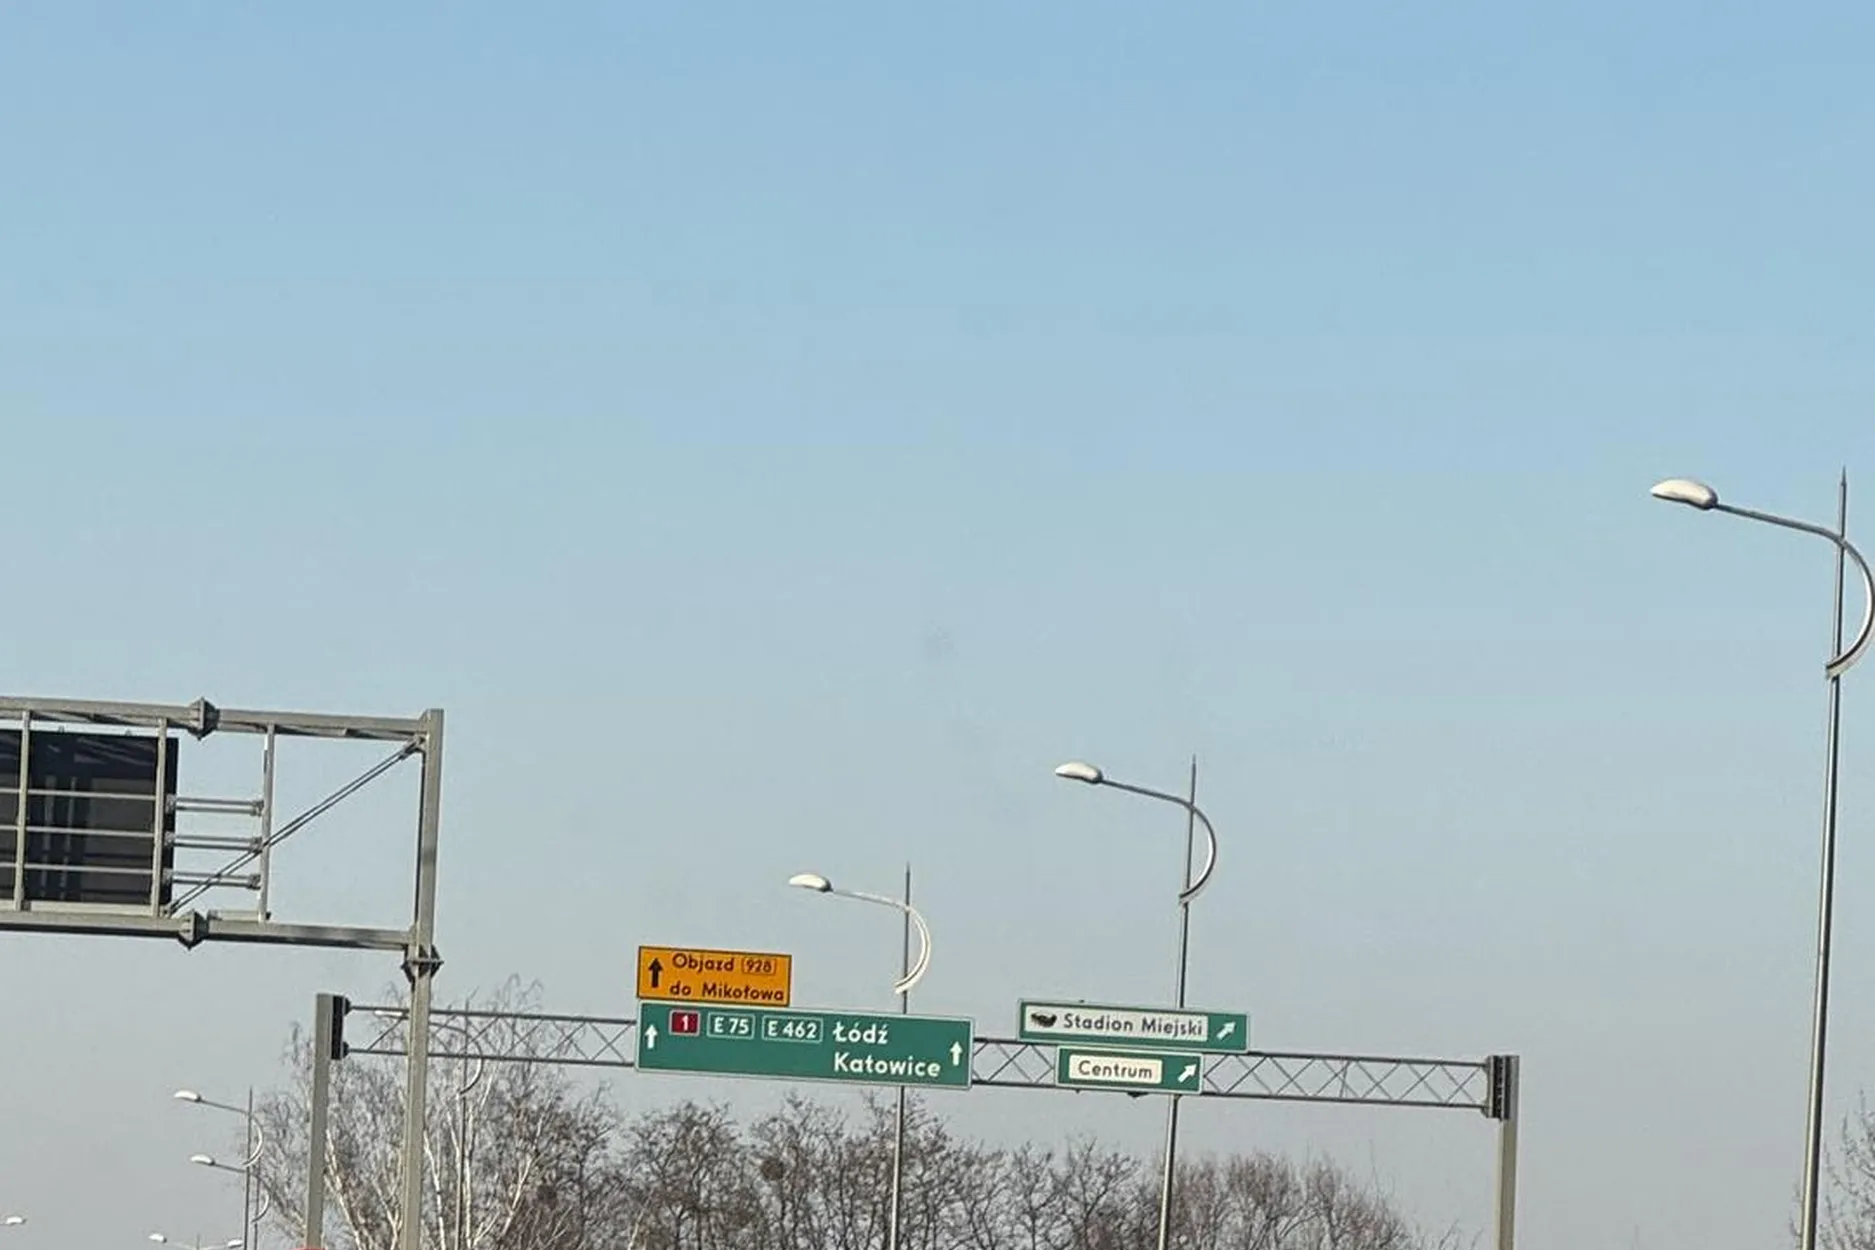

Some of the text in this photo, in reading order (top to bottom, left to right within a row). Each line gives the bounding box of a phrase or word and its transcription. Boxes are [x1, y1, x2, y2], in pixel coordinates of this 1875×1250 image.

[672, 952, 773, 973] Objazd 928
[669, 981, 784, 1001] do Mikołowa
[680, 1014, 690, 1032] 1
[713, 1016, 749, 1035] E 75
[767, 1020, 818, 1039] E 462
[832, 1020, 889, 1044] Łódź
[1063, 1012, 1203, 1037] Stadion Miejski
[834, 1051, 941, 1077] Katowice
[1077, 1059, 1153, 1079] Centrum
